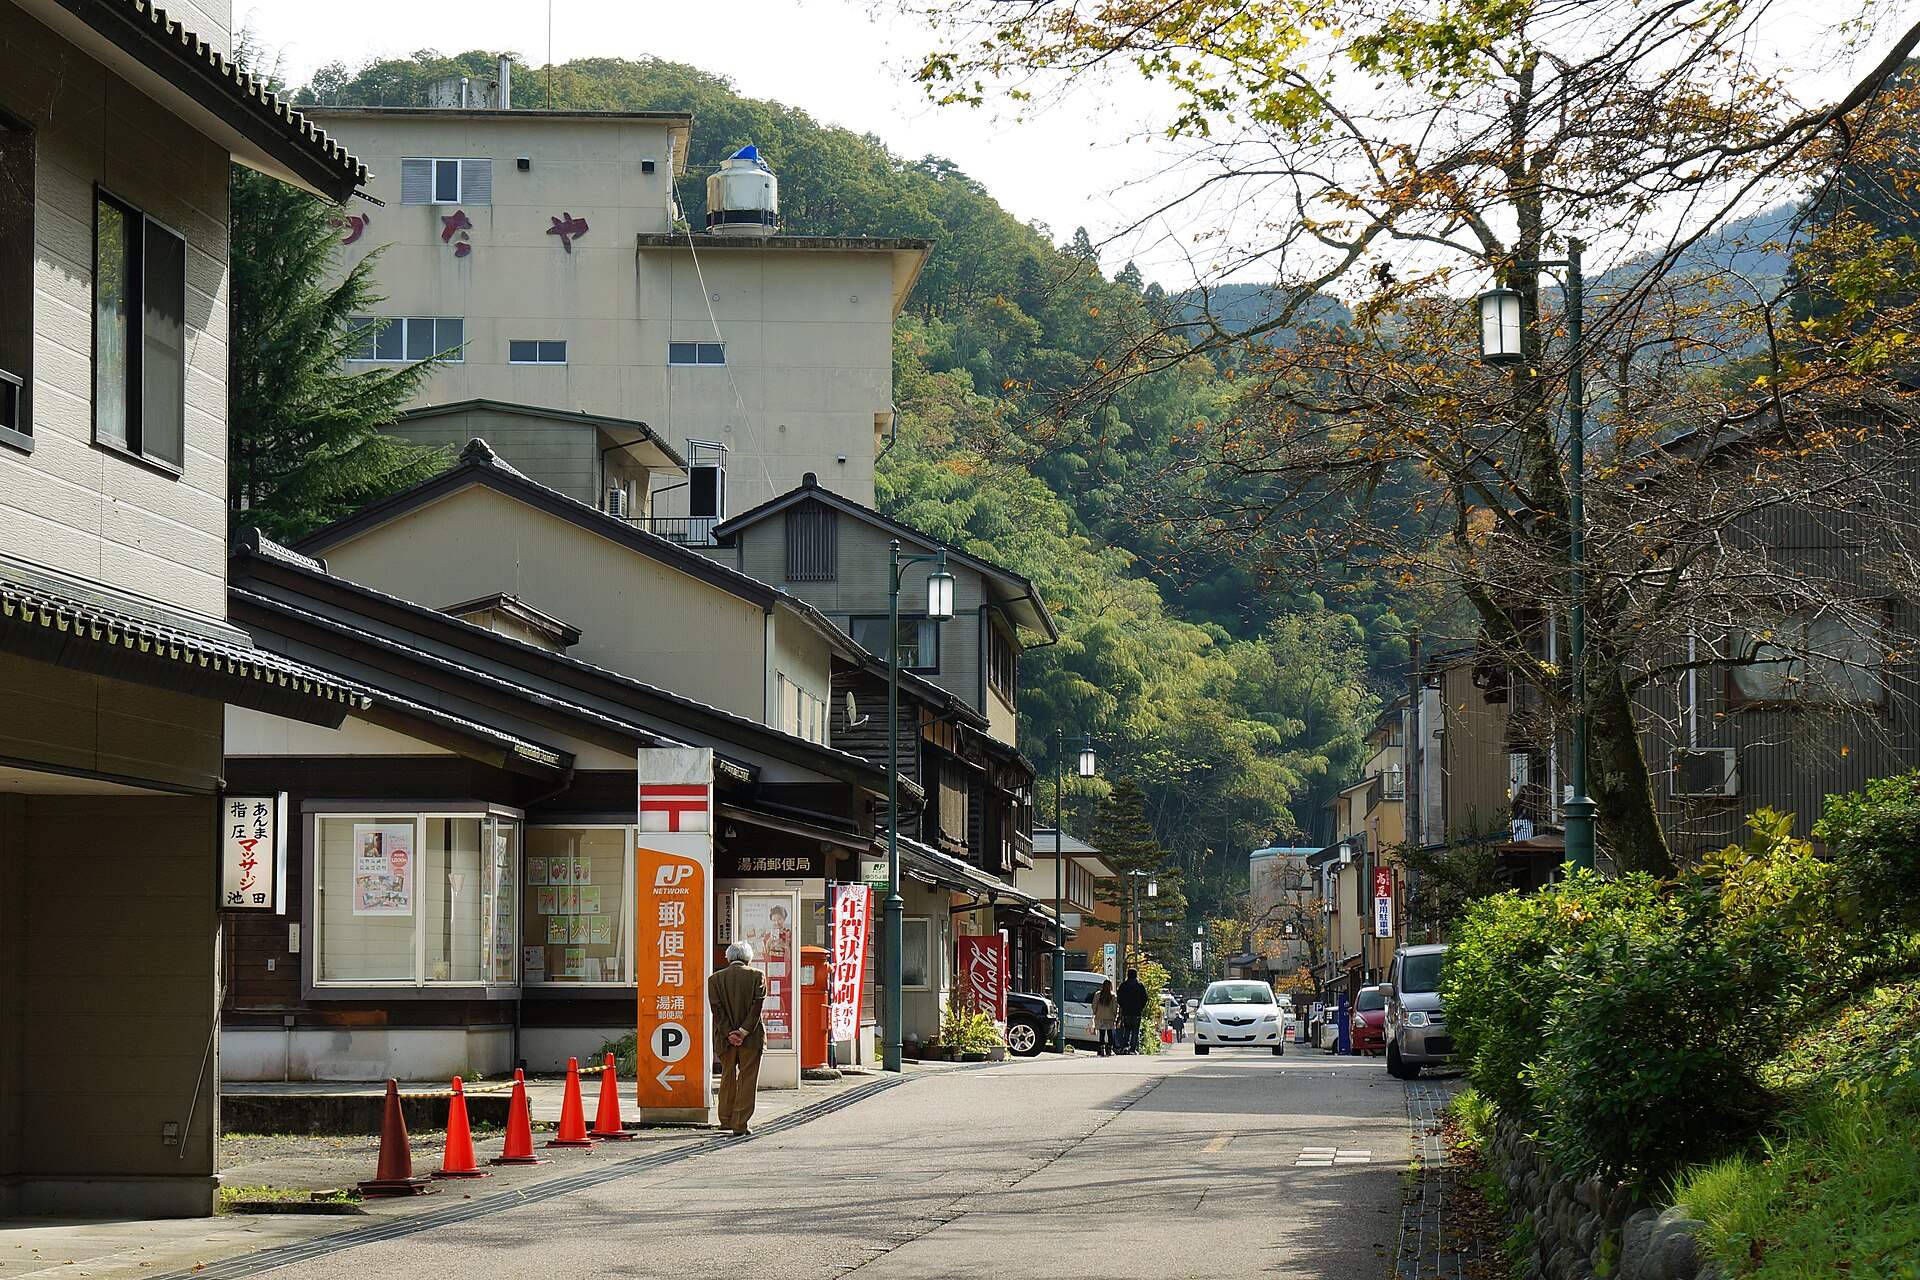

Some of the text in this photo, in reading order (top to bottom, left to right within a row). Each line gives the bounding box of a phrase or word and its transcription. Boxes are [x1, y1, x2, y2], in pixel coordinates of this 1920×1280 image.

[231, 802, 247, 839] 指圧
[253, 802, 268, 839] あんま
[238, 838, 259, 891] マッサージ
[737, 857, 811, 871] 湯涌郵便局
[228, 891, 266, 904] 池田
[1376, 872, 1387, 897] 高尾
[1378, 898, 1389, 936] 専用駐車場
[656, 901, 686, 987] 郵便局
[834, 897, 862, 1005] 年賀状印刷
[1107, 946, 1113, 954] P
[656, 995, 685, 1010] 湯涌
[657, 1011, 684, 1020] 郵便局
[661, 1028, 683, 1057] P
